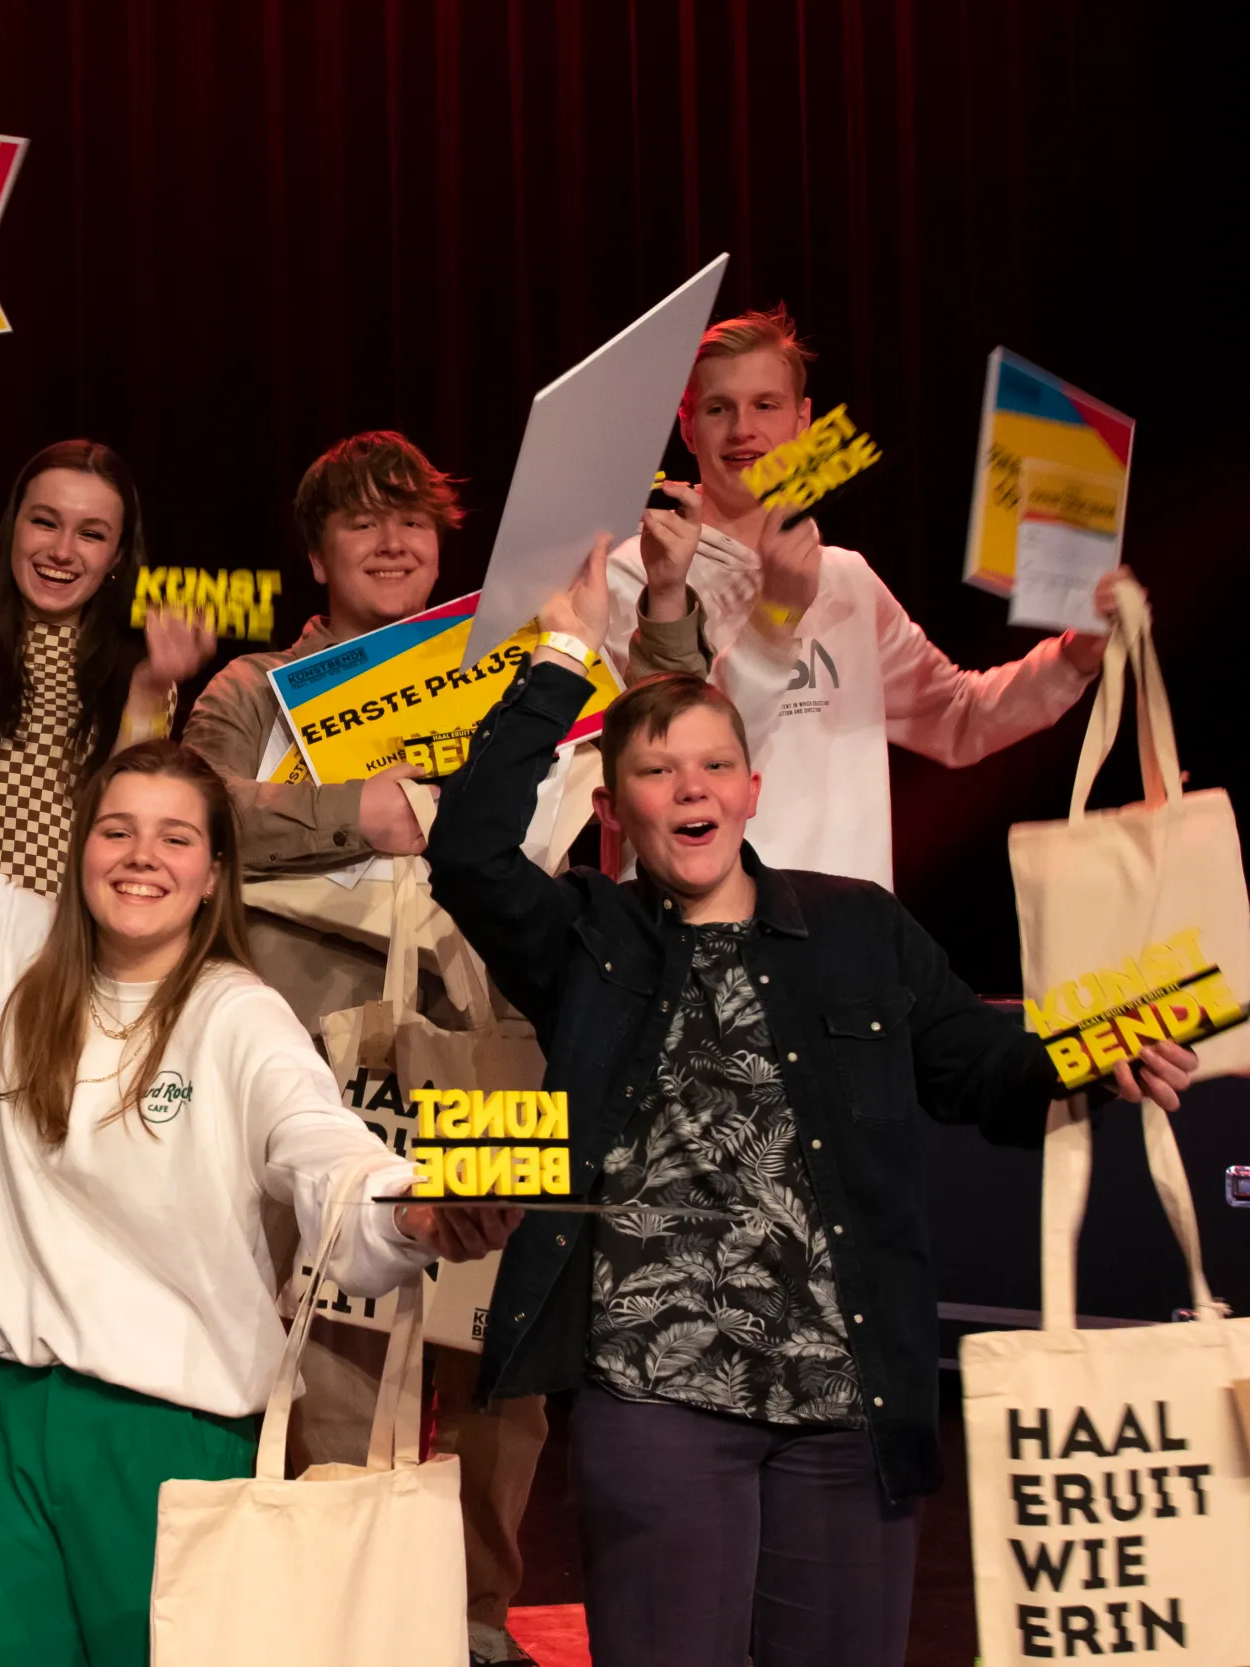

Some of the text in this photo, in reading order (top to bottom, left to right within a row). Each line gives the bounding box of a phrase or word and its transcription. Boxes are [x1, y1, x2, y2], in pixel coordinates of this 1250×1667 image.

[301, 684, 422, 746] EERSTE
[424, 645, 530, 699] PRIJS
[1023, 927, 1208, 1040] KUNST
[1045, 971, 1241, 1087] BENDE
[147, 1104, 169, 1113] CAFE
[162, 1080, 193, 1102] Rock
[1008, 1400, 1188, 1460] HAAL
[1010, 1464, 1212, 1527] ERUIT
[1008, 1535, 1147, 1592] WIE
[1016, 1598, 1187, 1658] ERIN
